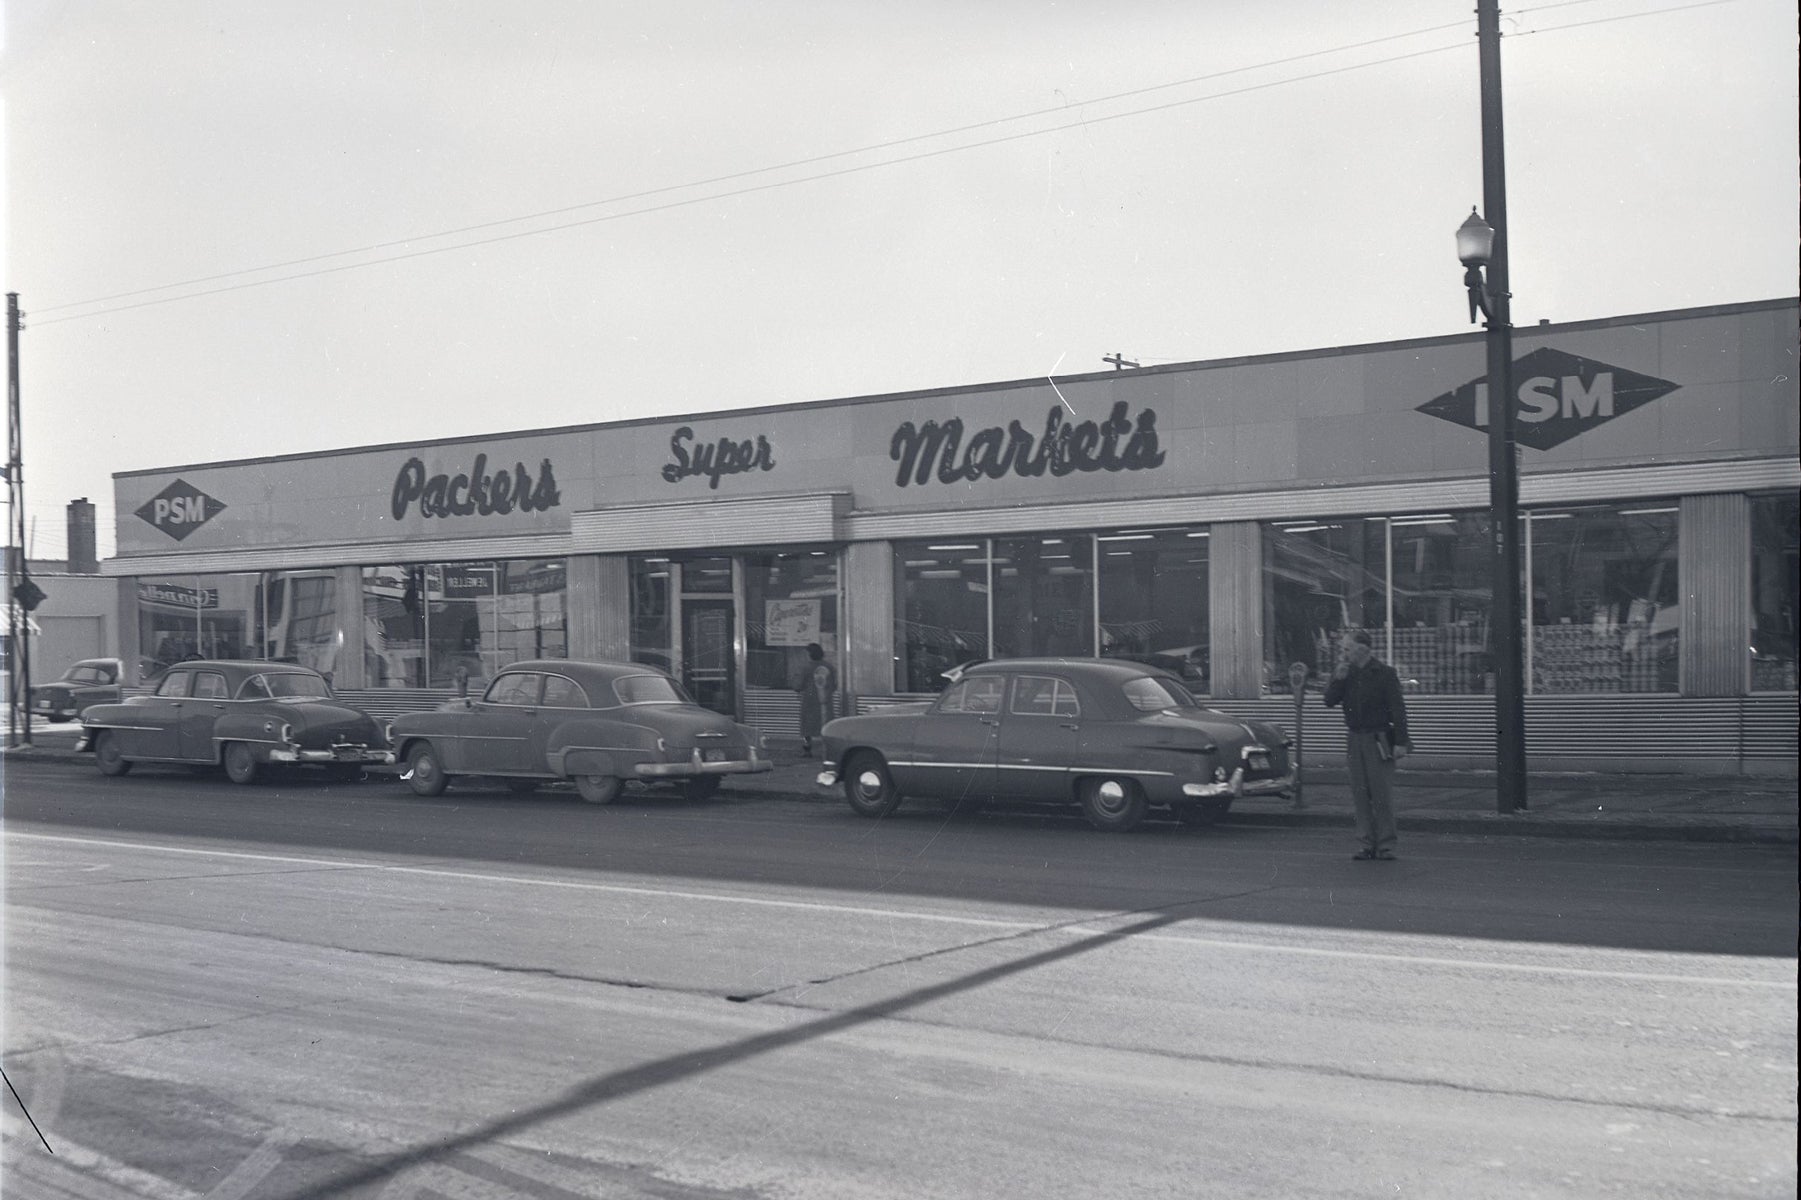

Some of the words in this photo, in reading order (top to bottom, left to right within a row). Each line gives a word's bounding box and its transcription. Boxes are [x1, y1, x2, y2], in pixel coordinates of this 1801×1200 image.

[391, 453, 562, 521] Packers
[661, 426, 776, 490] Super
[889, 400, 1167, 489] Markets
[154, 495, 206, 526] PSM
